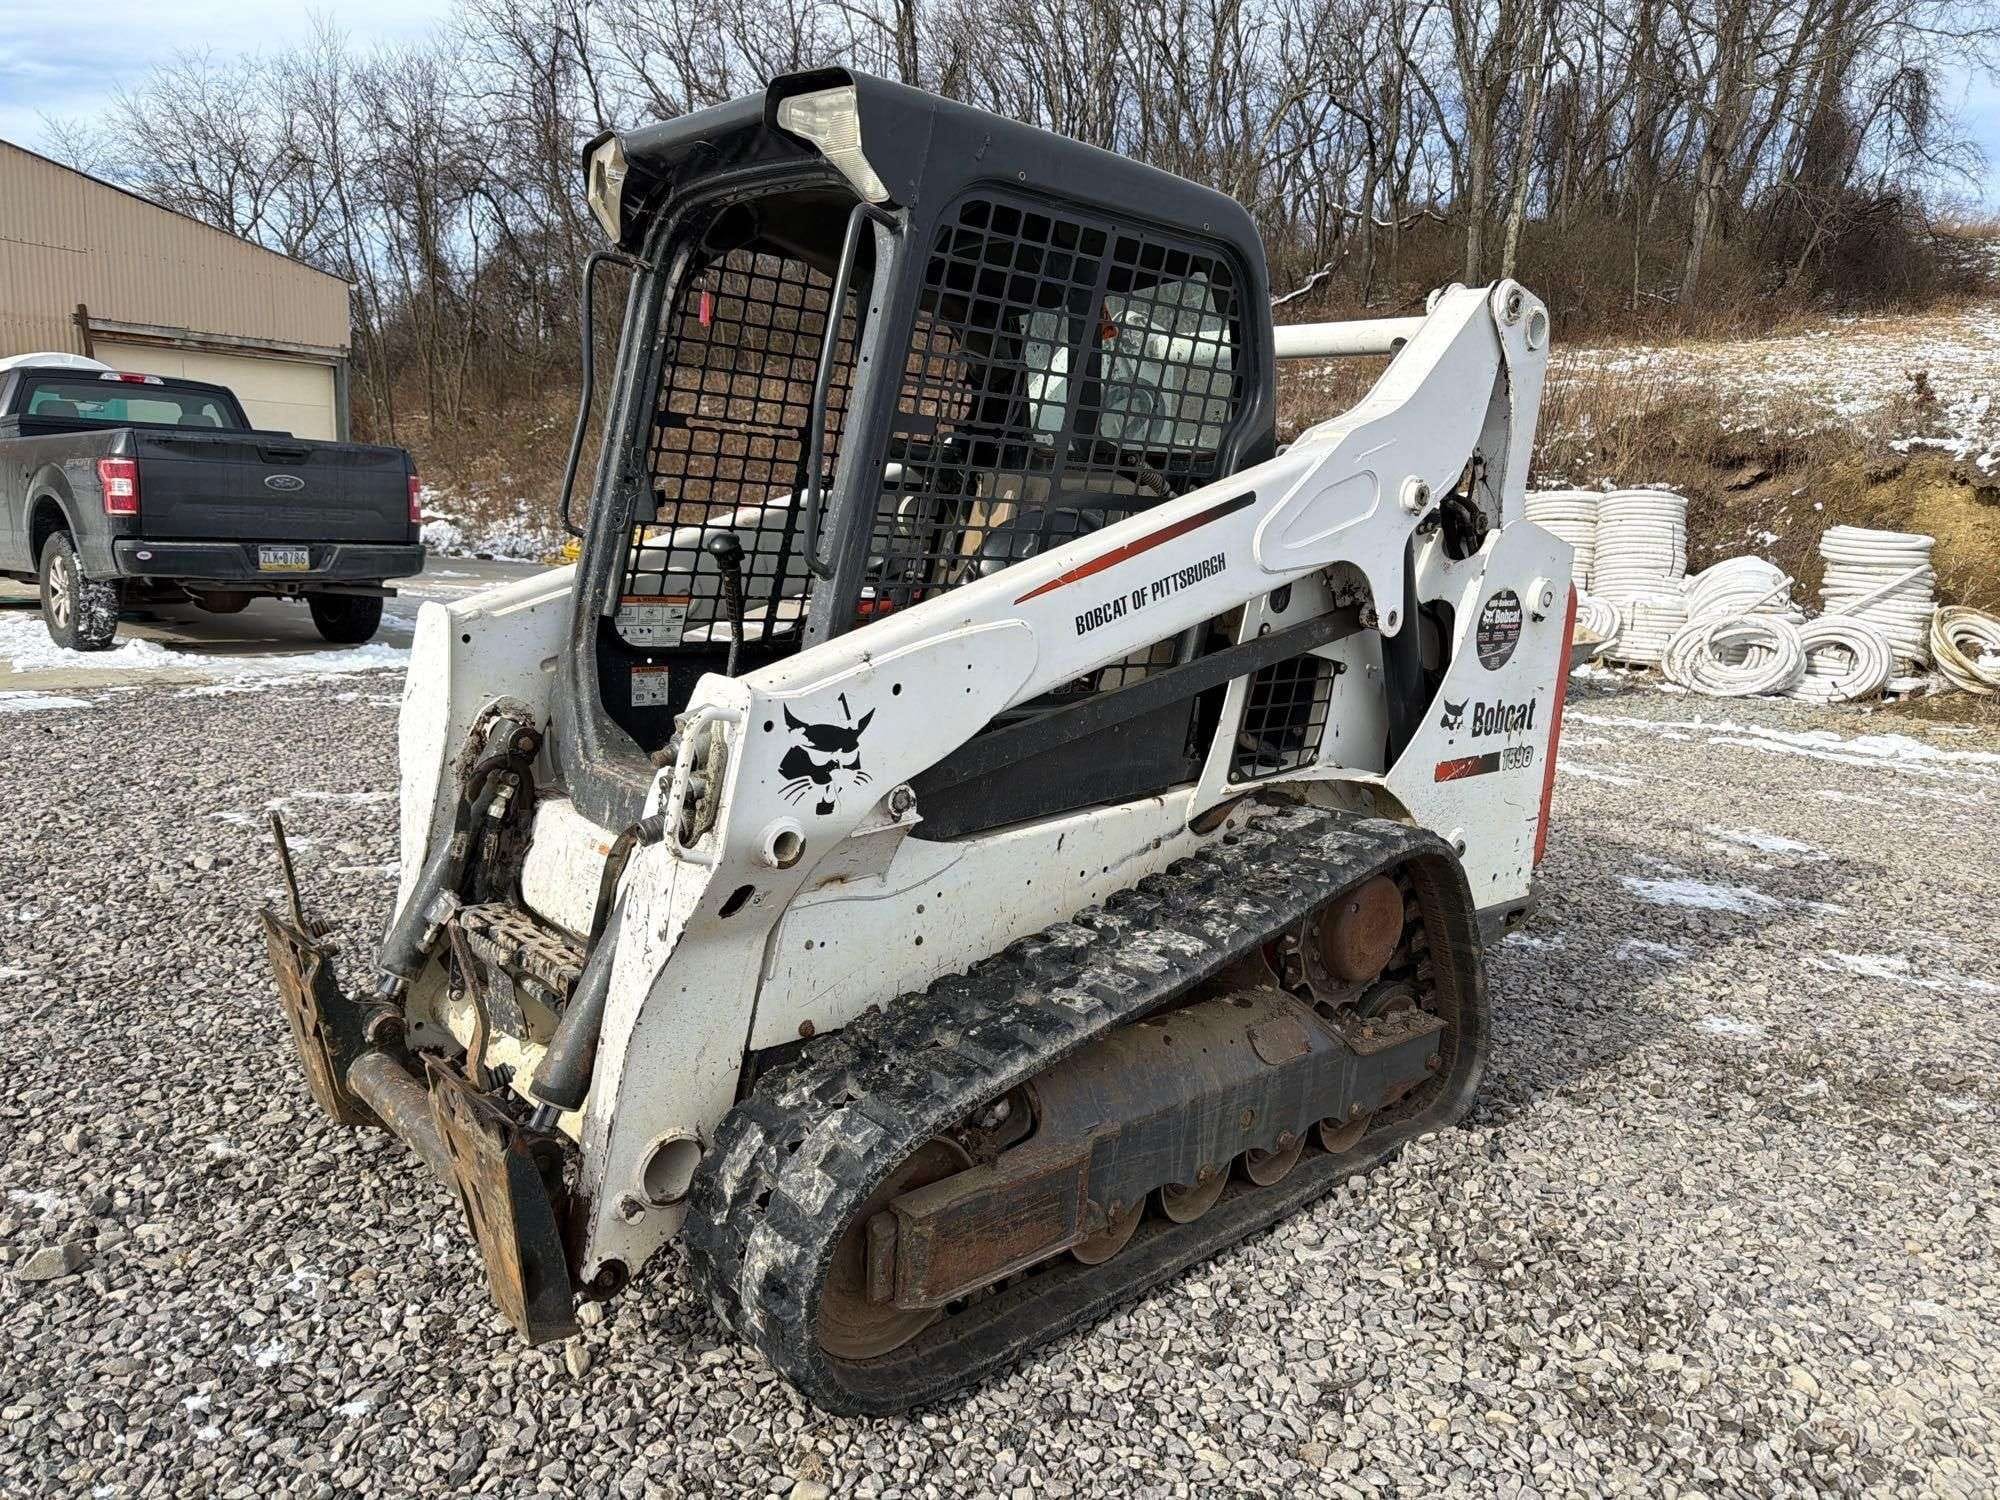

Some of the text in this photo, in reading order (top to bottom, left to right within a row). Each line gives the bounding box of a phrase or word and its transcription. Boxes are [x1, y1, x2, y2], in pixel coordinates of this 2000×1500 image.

[1075, 552, 1226, 635] BOBCAT OF PITTSBURGH
[1495, 609, 1520, 624] Bobcat
[1472, 698, 1536, 738] Bobcat
